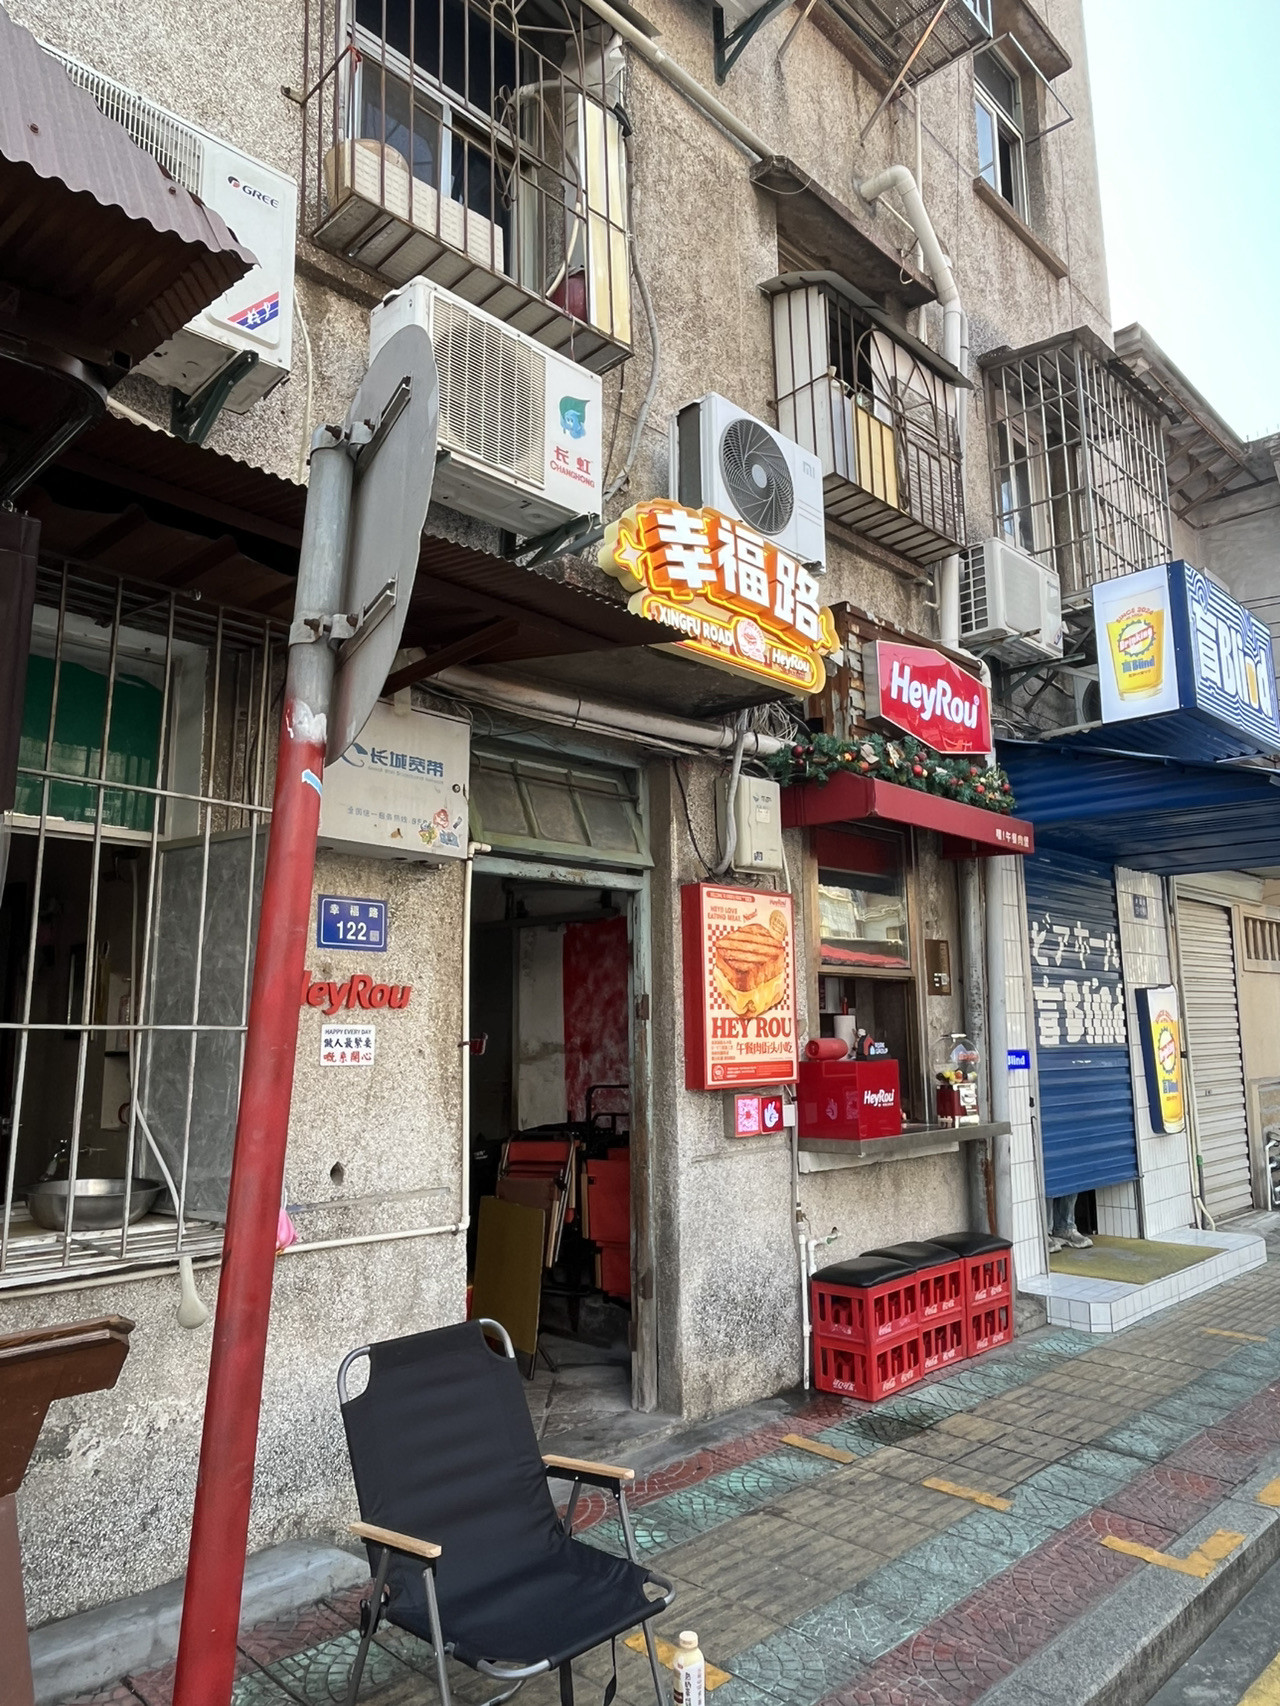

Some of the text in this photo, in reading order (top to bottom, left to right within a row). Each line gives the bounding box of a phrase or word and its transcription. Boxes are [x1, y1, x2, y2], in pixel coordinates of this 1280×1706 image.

[242, 185, 279, 209] GREE
[554, 445, 592, 476] 长虹
[549, 460, 595, 488] CHANGHONG
[656, 508, 820, 642] 幸福路
[658, 604, 734, 647] XINGFU ROAD
[771, 647, 810, 673] HeyRou
[370, 747, 444, 778] 长城宽带
[329, 903, 379, 918] 幸福路
[336, 921, 367, 941] 122
[1031, 912, 1121, 971] ビアホール
[711, 1016, 792, 1038] HEY ROU
[736, 1041, 794, 1056] 午餐肉街头小吃
[863, 1088, 895, 1107] HeyRou
